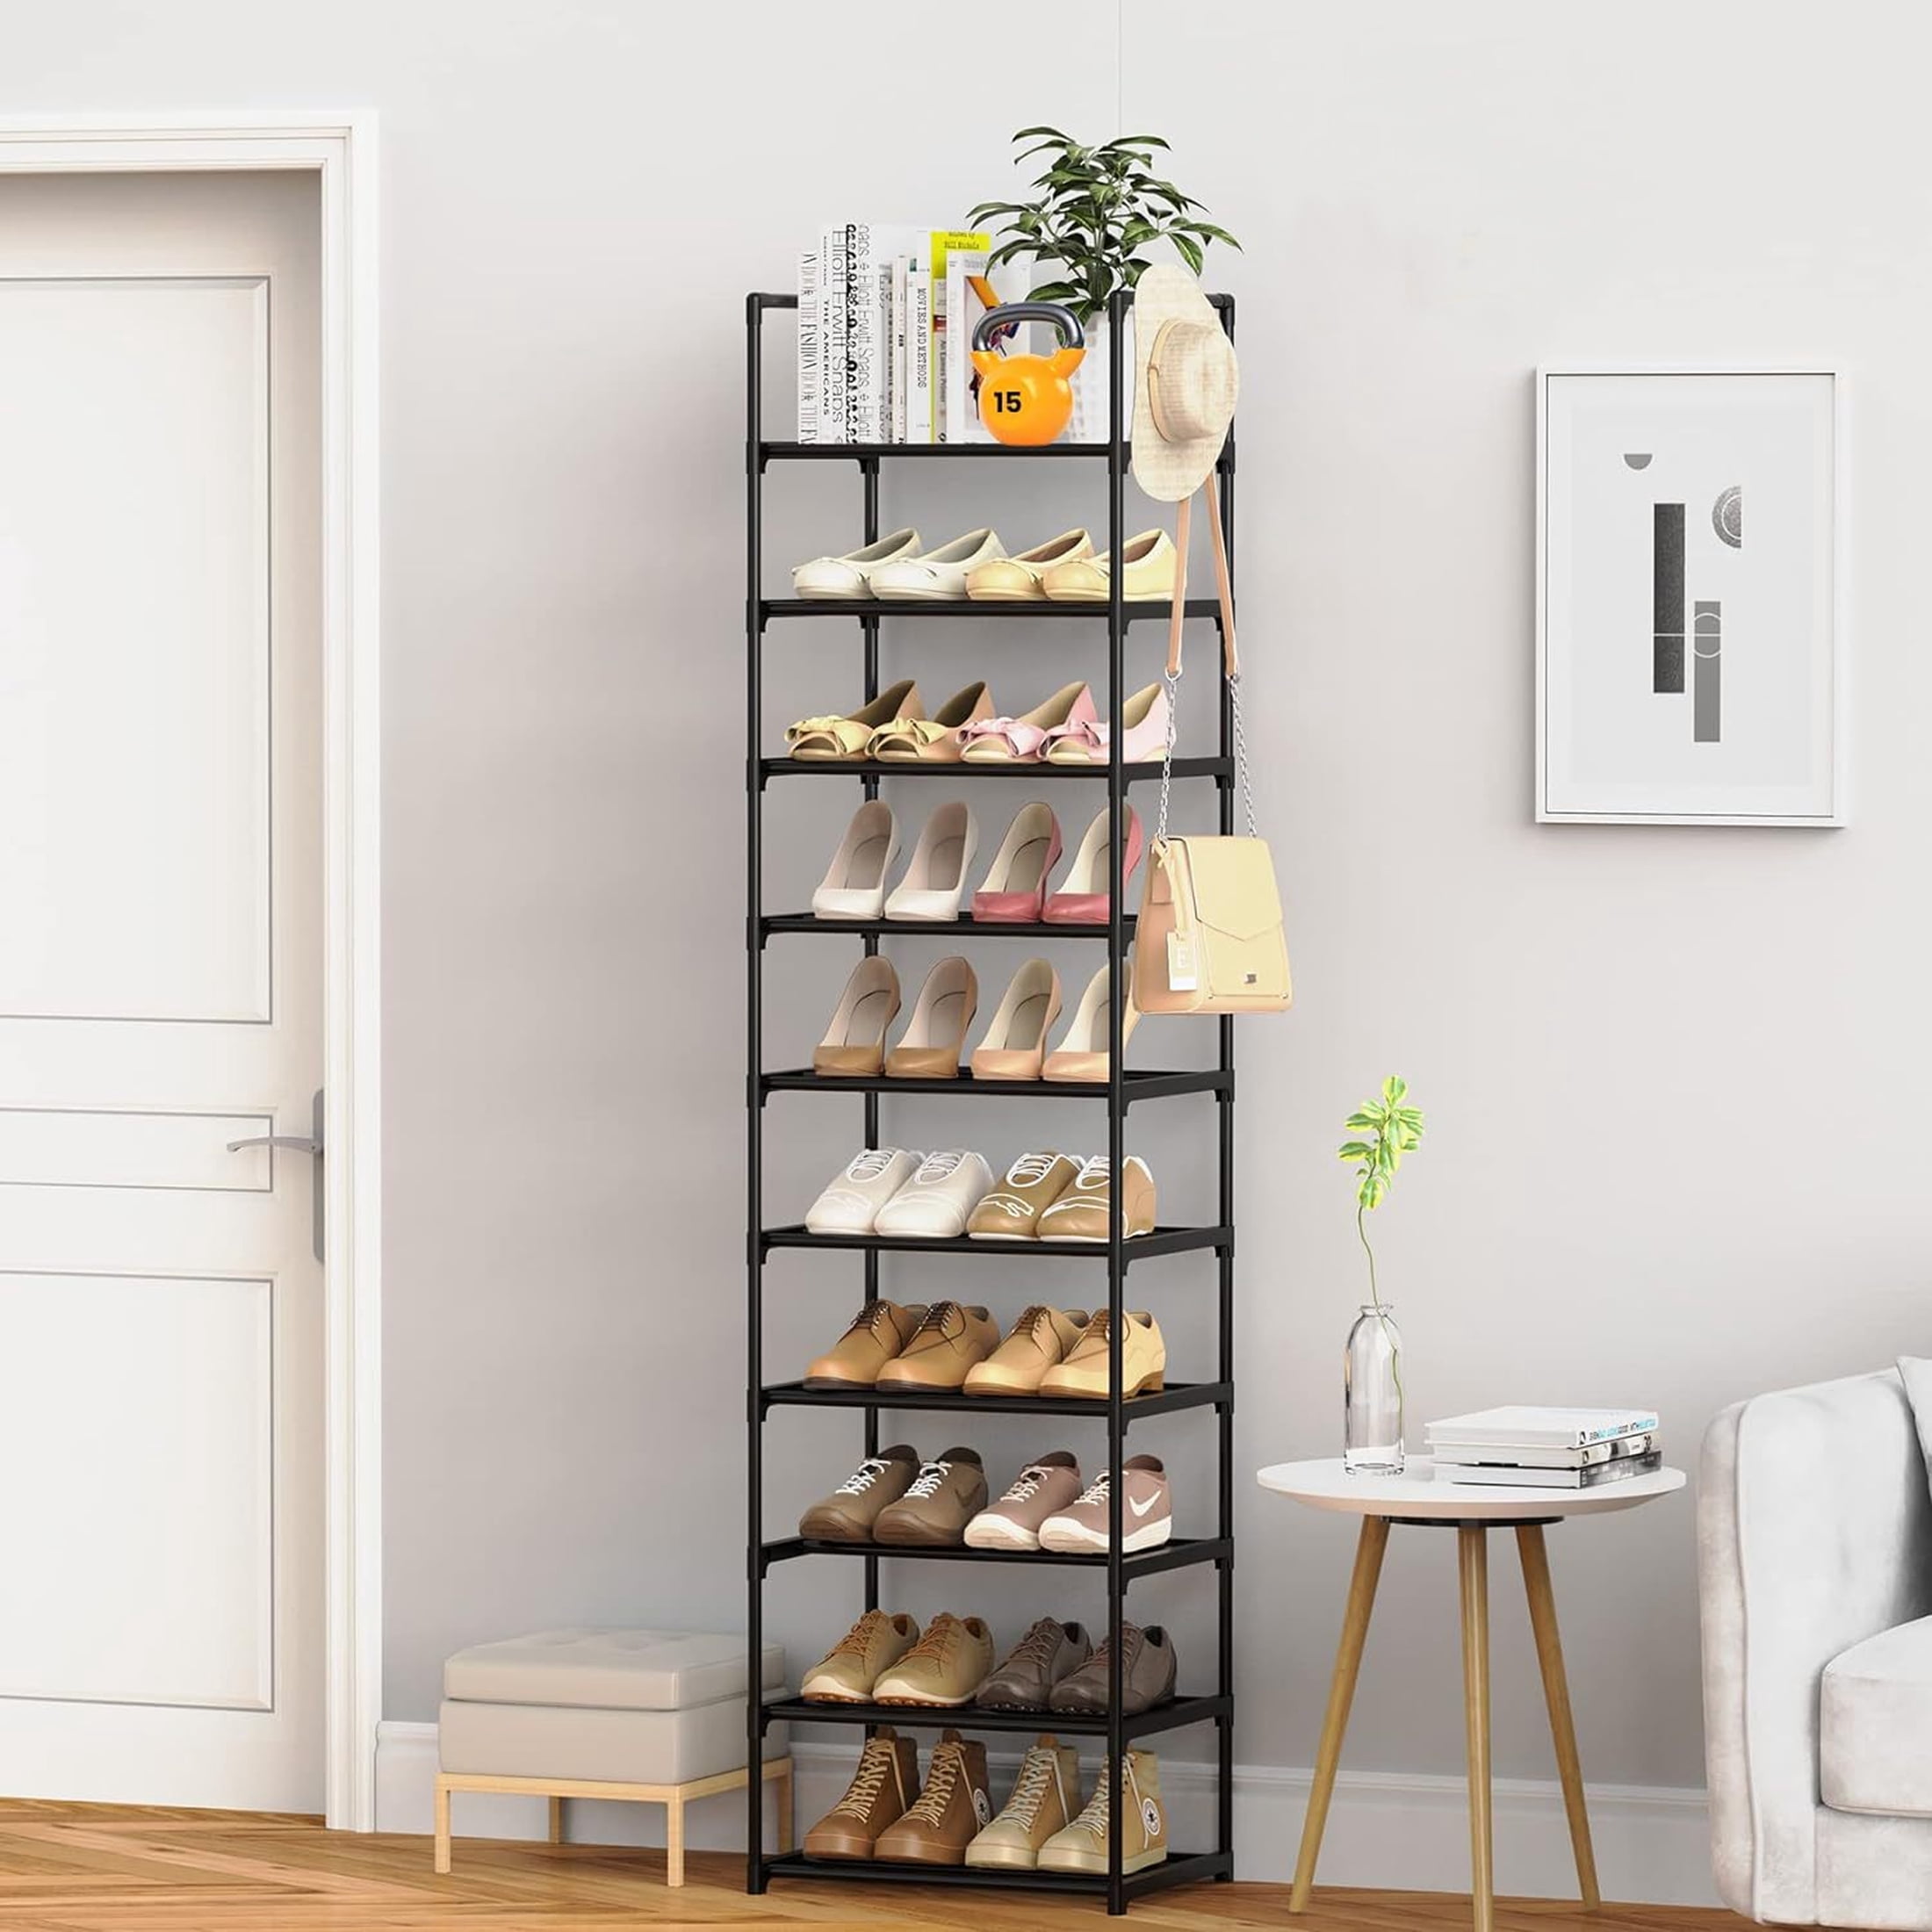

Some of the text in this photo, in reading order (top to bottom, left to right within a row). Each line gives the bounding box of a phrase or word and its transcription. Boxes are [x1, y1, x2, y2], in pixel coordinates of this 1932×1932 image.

[917, 288, 926, 388] MOVIES AND METHODS
[994, 392, 1021, 413] 15
